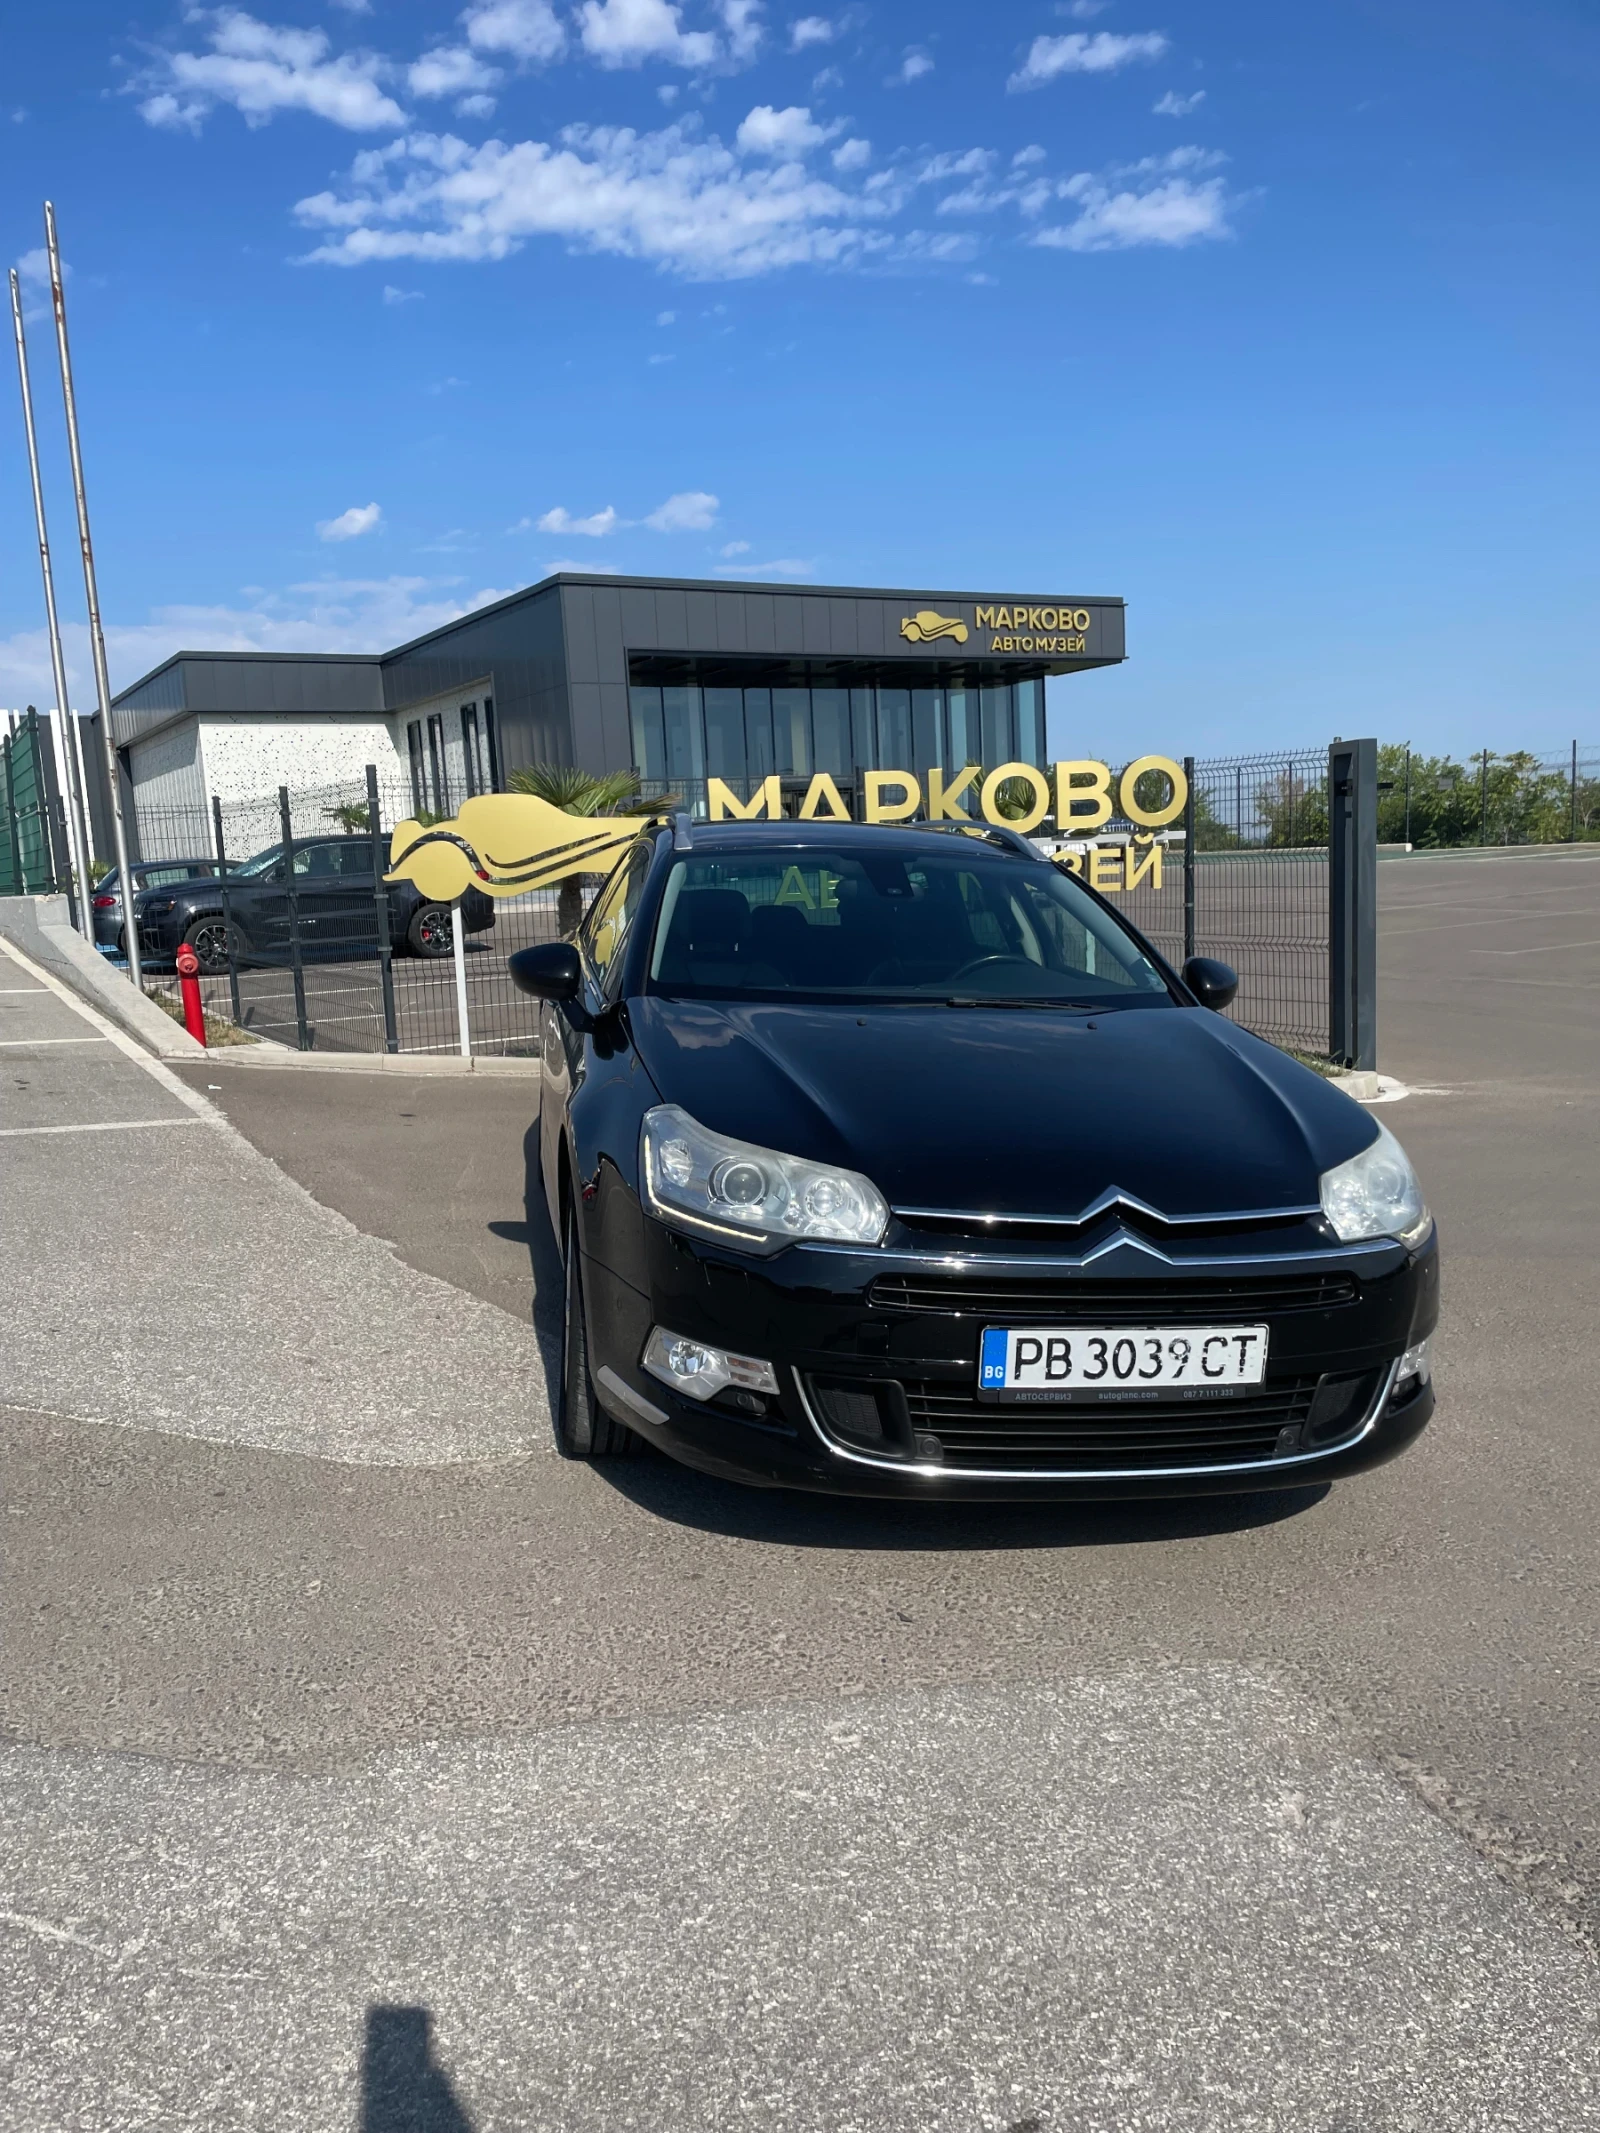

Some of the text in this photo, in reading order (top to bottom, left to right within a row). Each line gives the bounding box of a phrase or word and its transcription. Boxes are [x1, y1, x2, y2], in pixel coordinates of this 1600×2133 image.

[975, 606, 1091, 631] МАРКОВО
[707, 755, 1188, 834] МАРКОВО
[1014, 1334, 1258, 1380] PB 3039 CT
[984, 1365, 1004, 1380] BG
[1015, 1392, 1072, 1401] АВТОСЕРВИЗ
